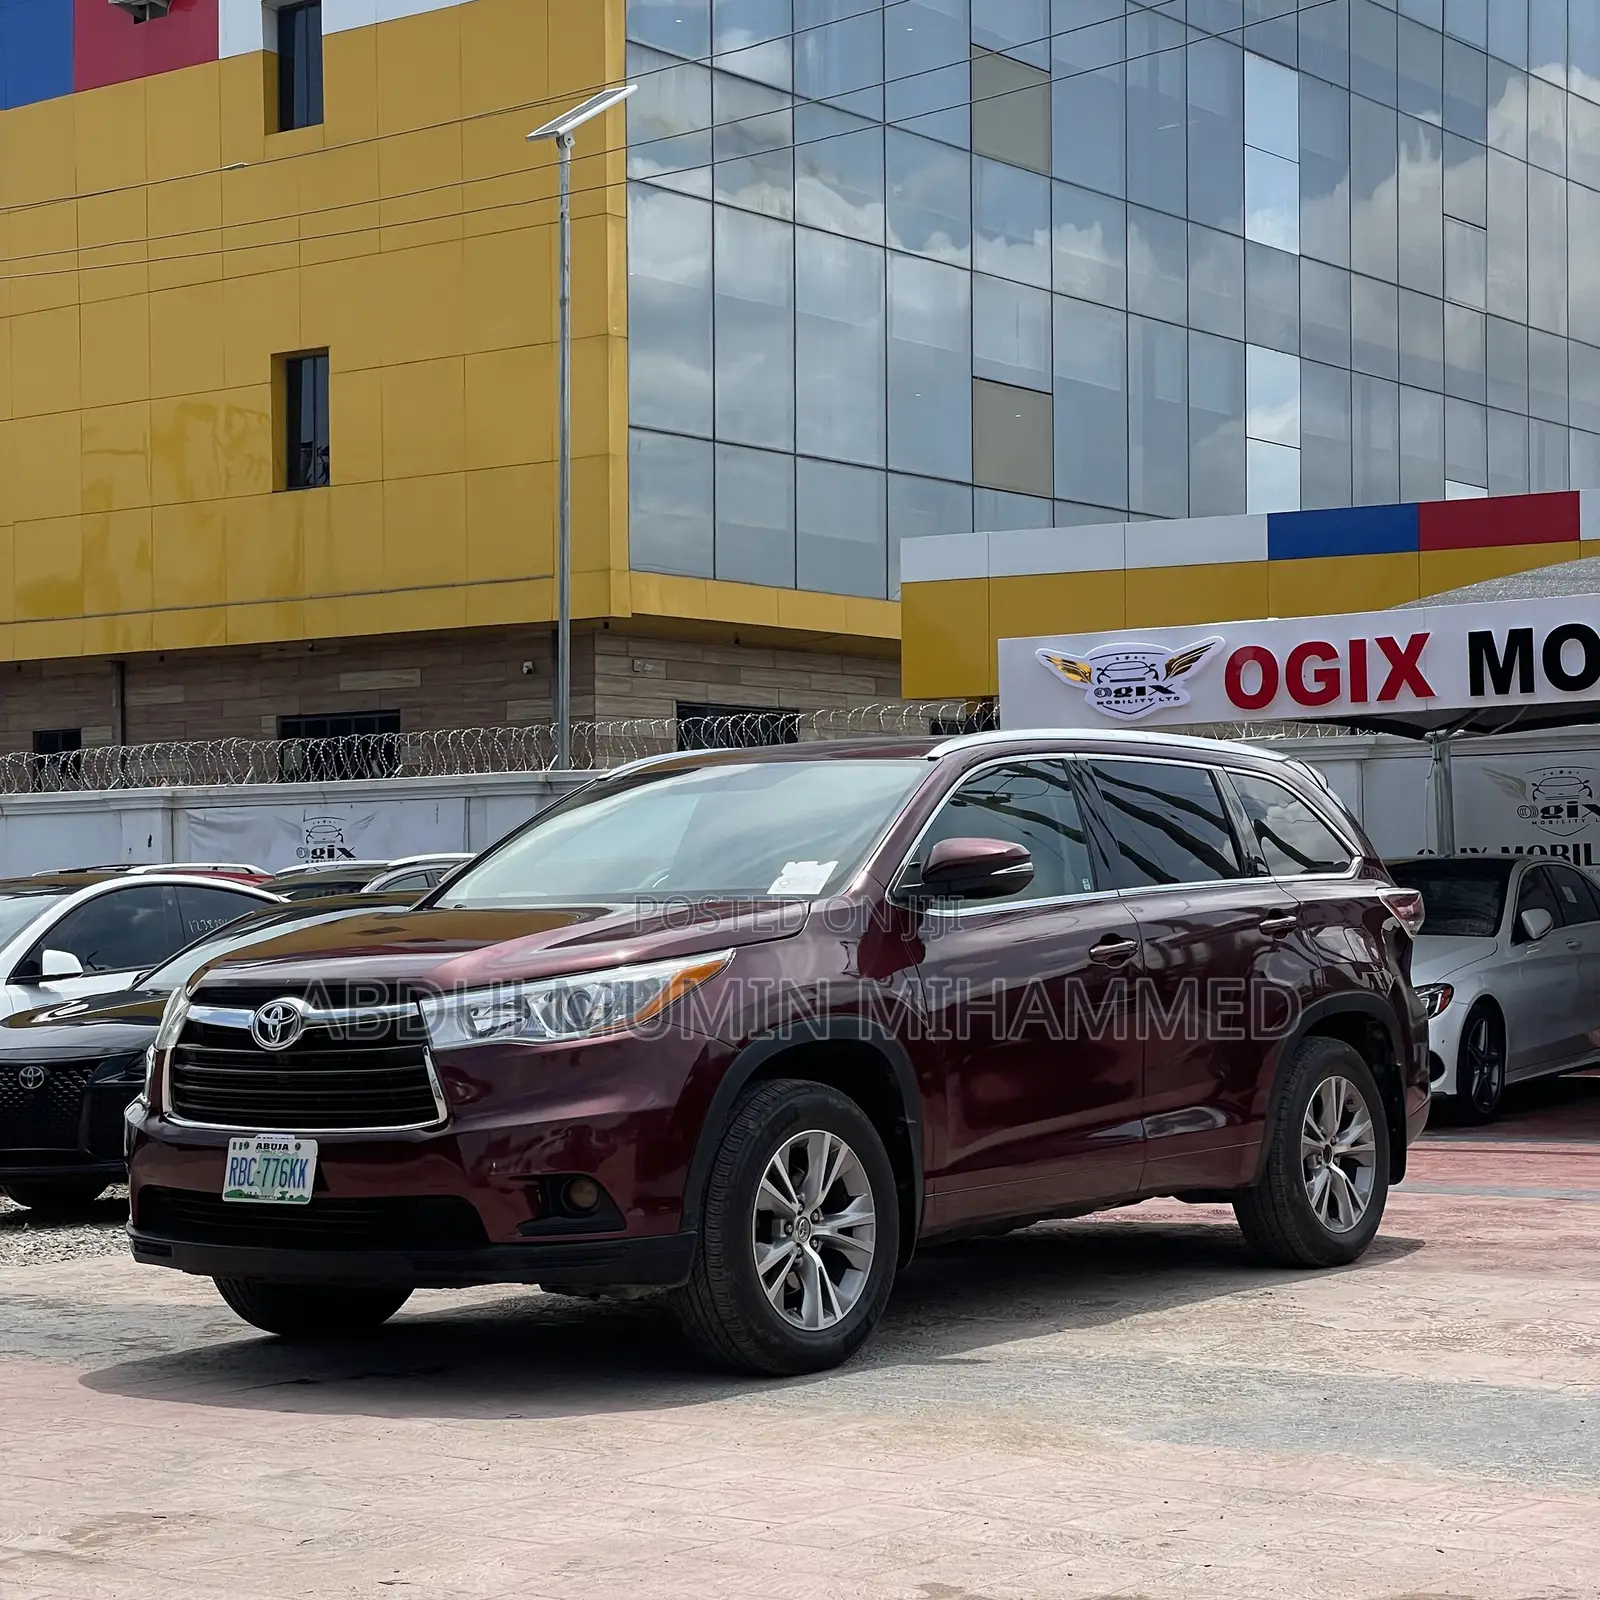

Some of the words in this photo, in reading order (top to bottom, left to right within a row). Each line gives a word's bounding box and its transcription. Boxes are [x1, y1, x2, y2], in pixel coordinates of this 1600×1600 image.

[1224, 632, 1437, 710] OGIX
[1468, 623, 1600, 697] MO
[1096, 697, 1154, 705] MOBILITY
[255, 1142, 289, 1151] ABUJA
